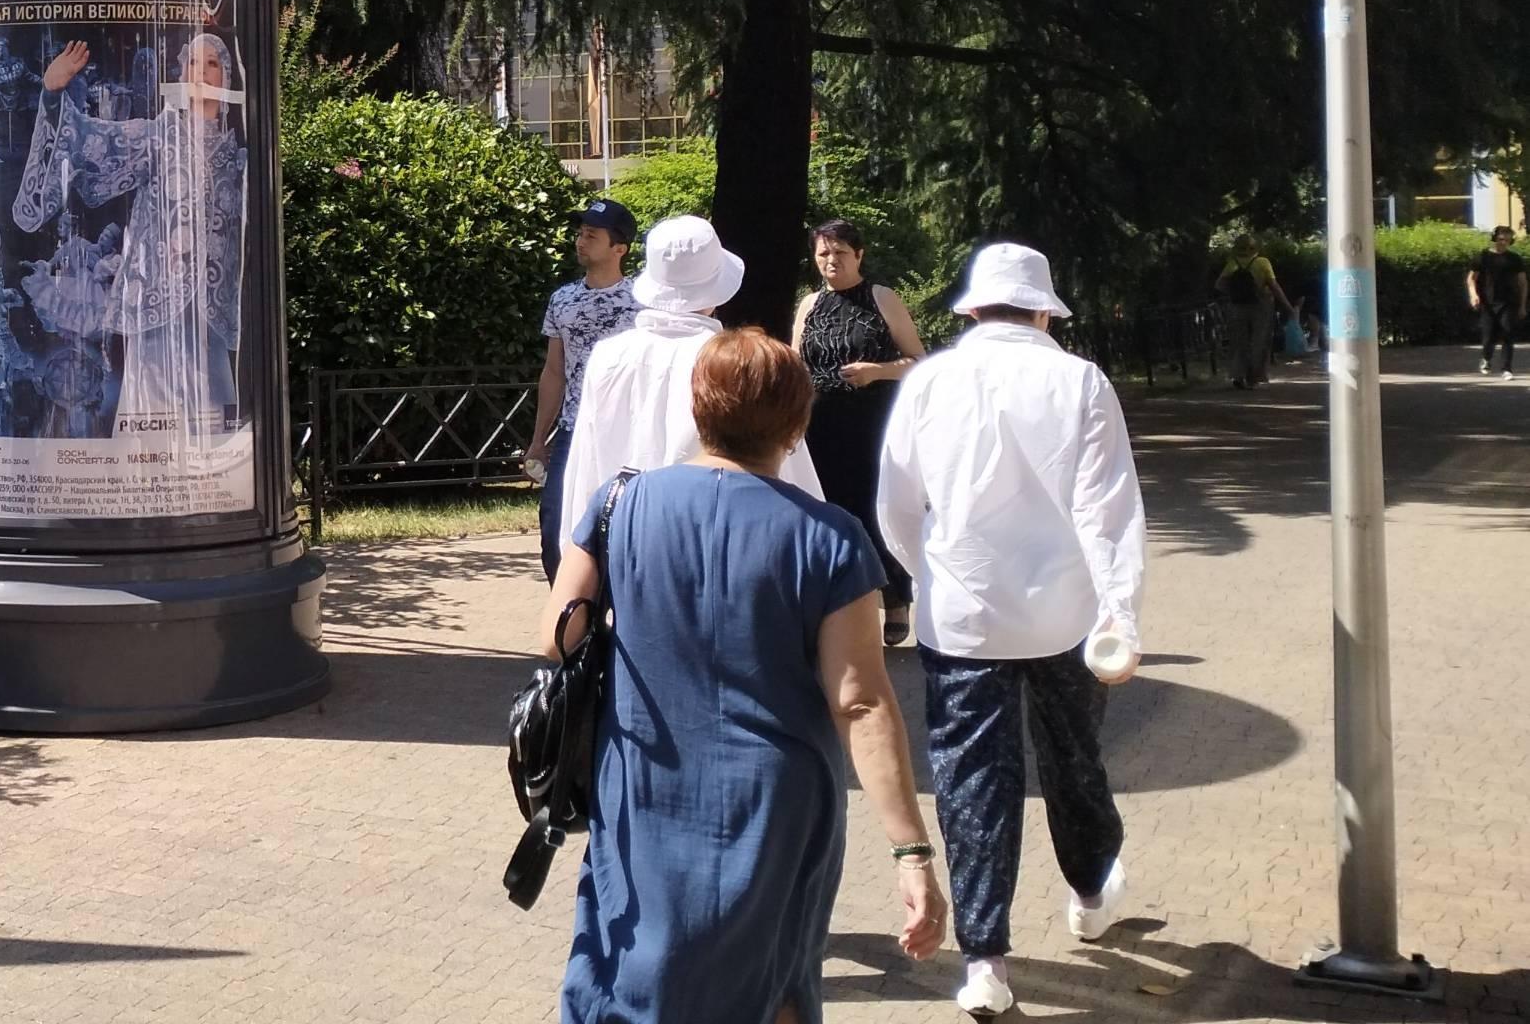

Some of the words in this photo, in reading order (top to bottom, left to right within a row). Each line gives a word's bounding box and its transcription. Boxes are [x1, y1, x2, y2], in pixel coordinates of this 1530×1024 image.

[15, 4, 83, 21] ИСТОРИЯ
[88, 0, 154, 20] ВЕЛИКОЙ
[56, 449, 87, 457] SOCHI
